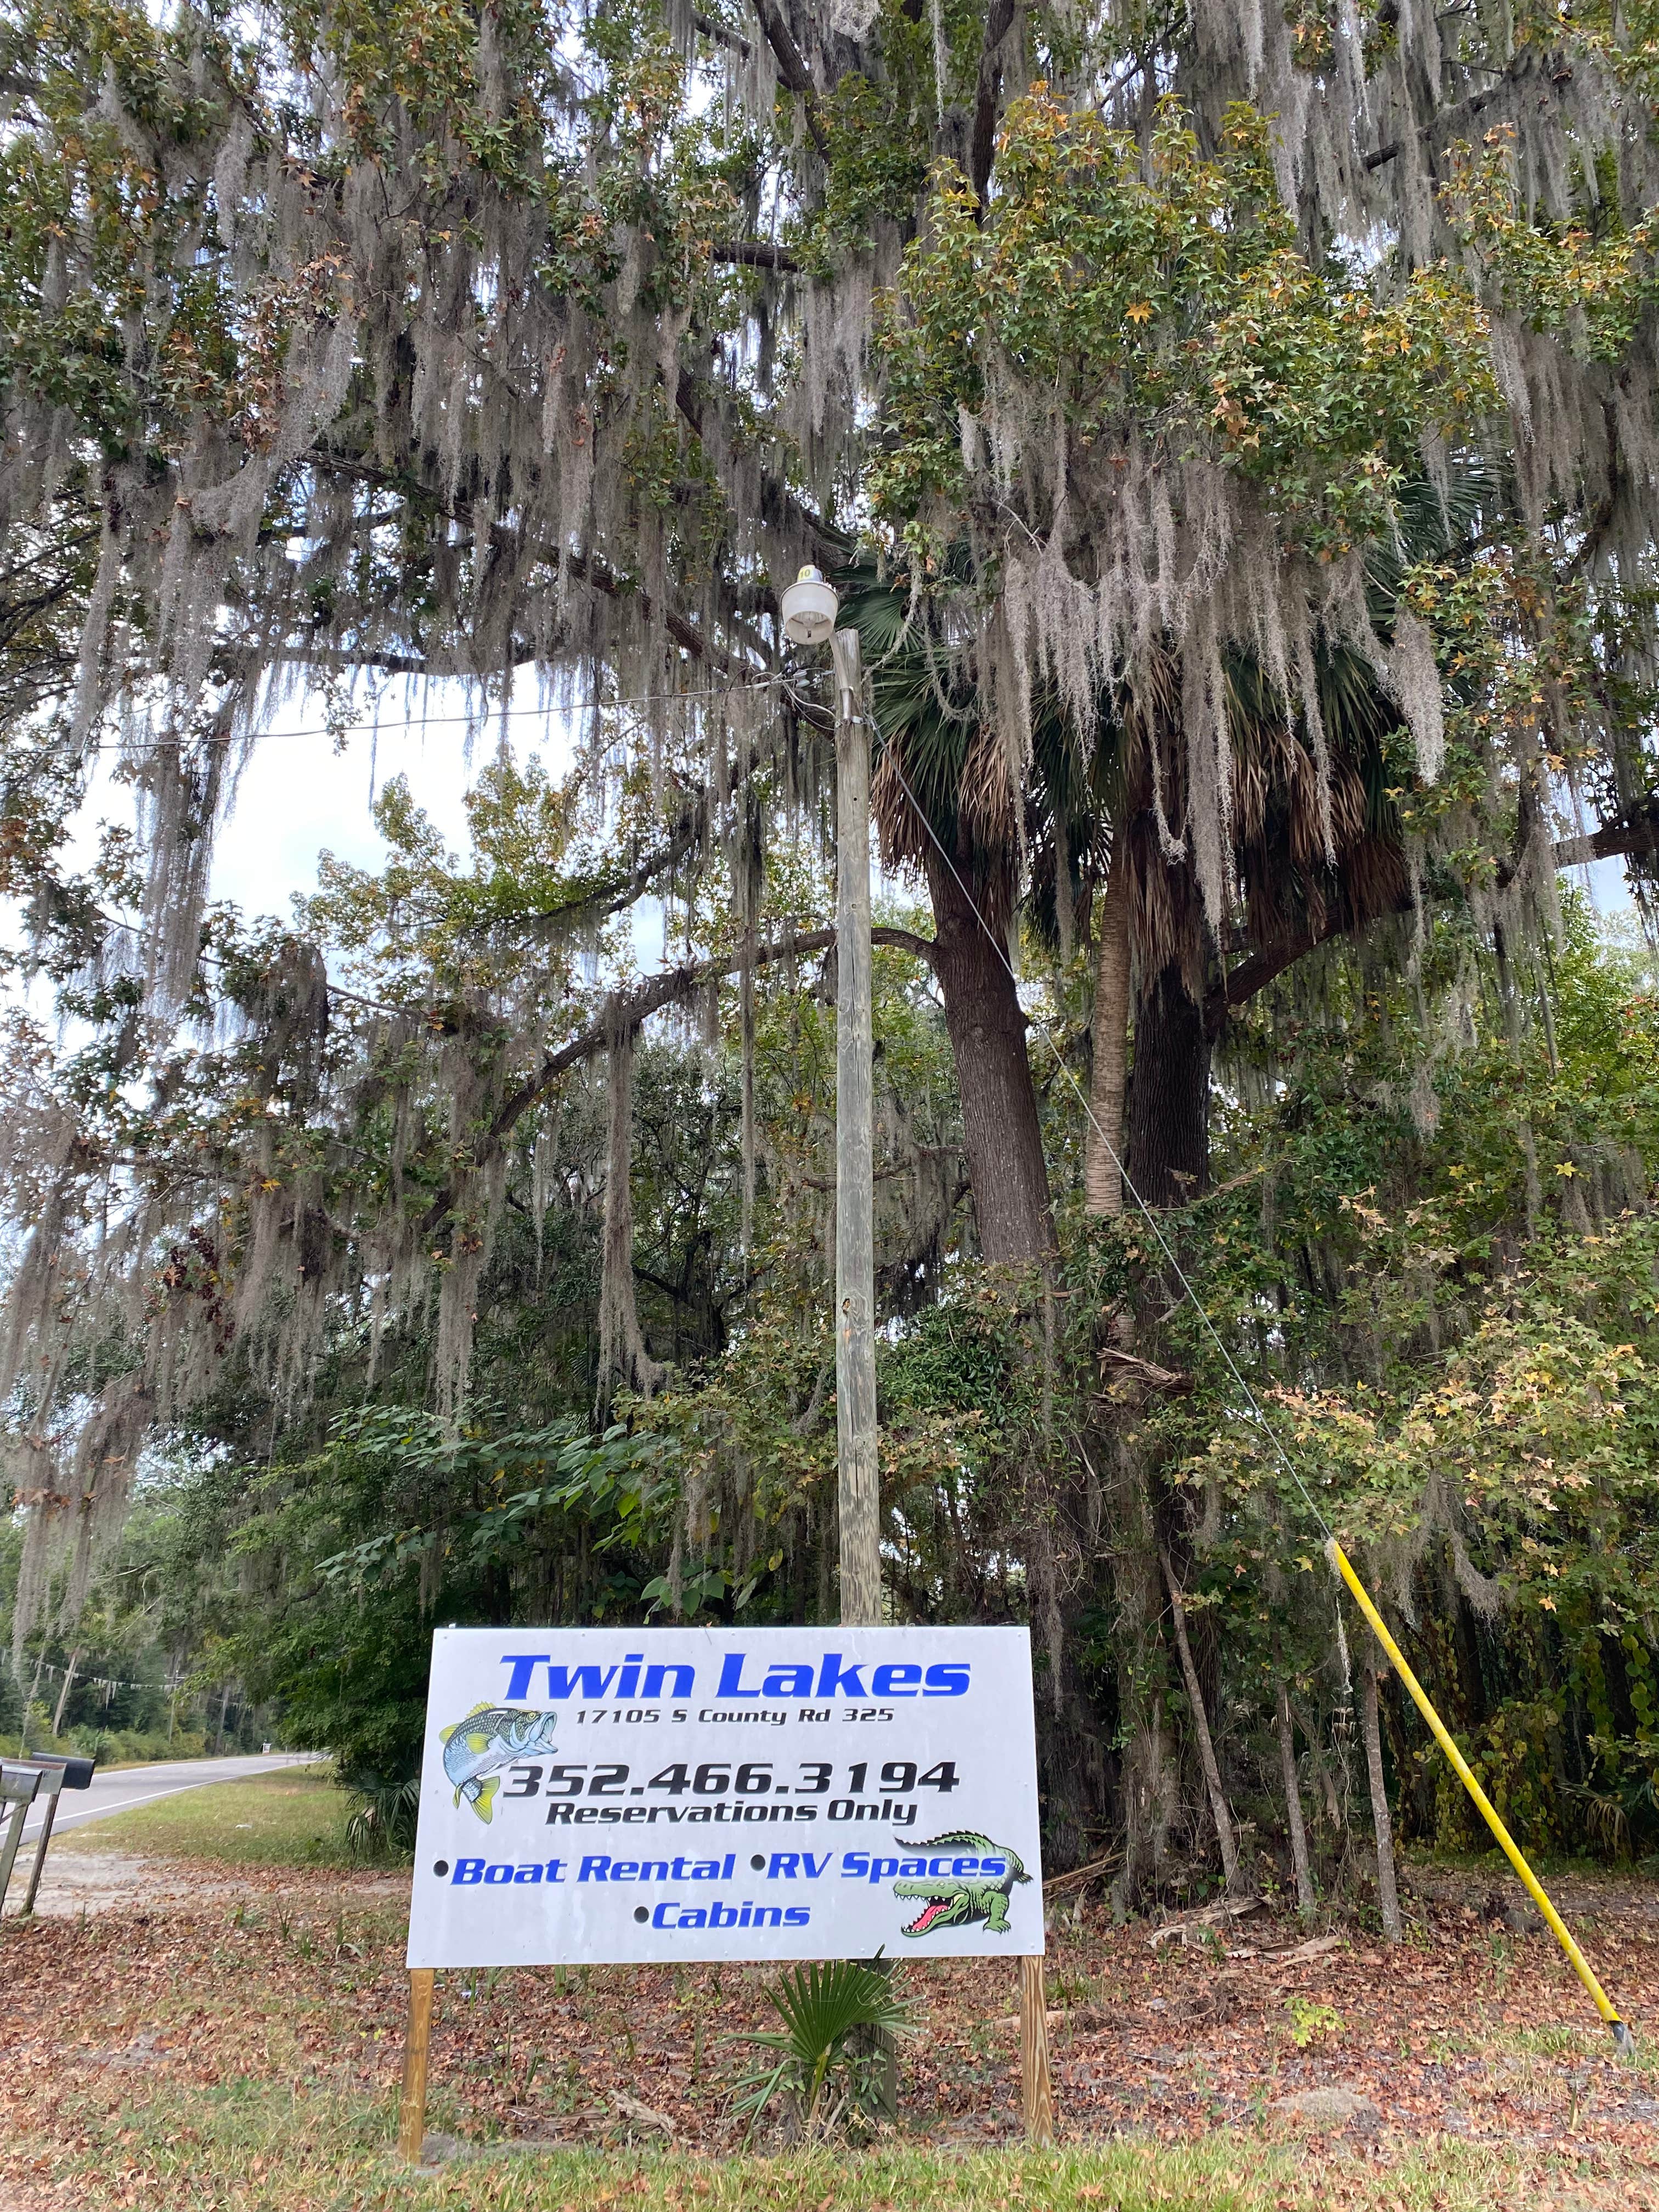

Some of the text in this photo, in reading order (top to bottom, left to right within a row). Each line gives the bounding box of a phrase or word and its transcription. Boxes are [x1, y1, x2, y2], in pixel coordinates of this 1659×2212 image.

[800, 569, 810, 578] 10
[500, 1653, 971, 1701] Twin Lakes
[576, 1708, 894, 1725] 17105 S County Rd 325
[503, 1762, 960, 1798] 352.466.3194
[545, 1799, 918, 1826] Reservations Only
[450, 1852, 1006, 1886] Boat Rental RV Spaces
[651, 1900, 811, 1929] Cabins
